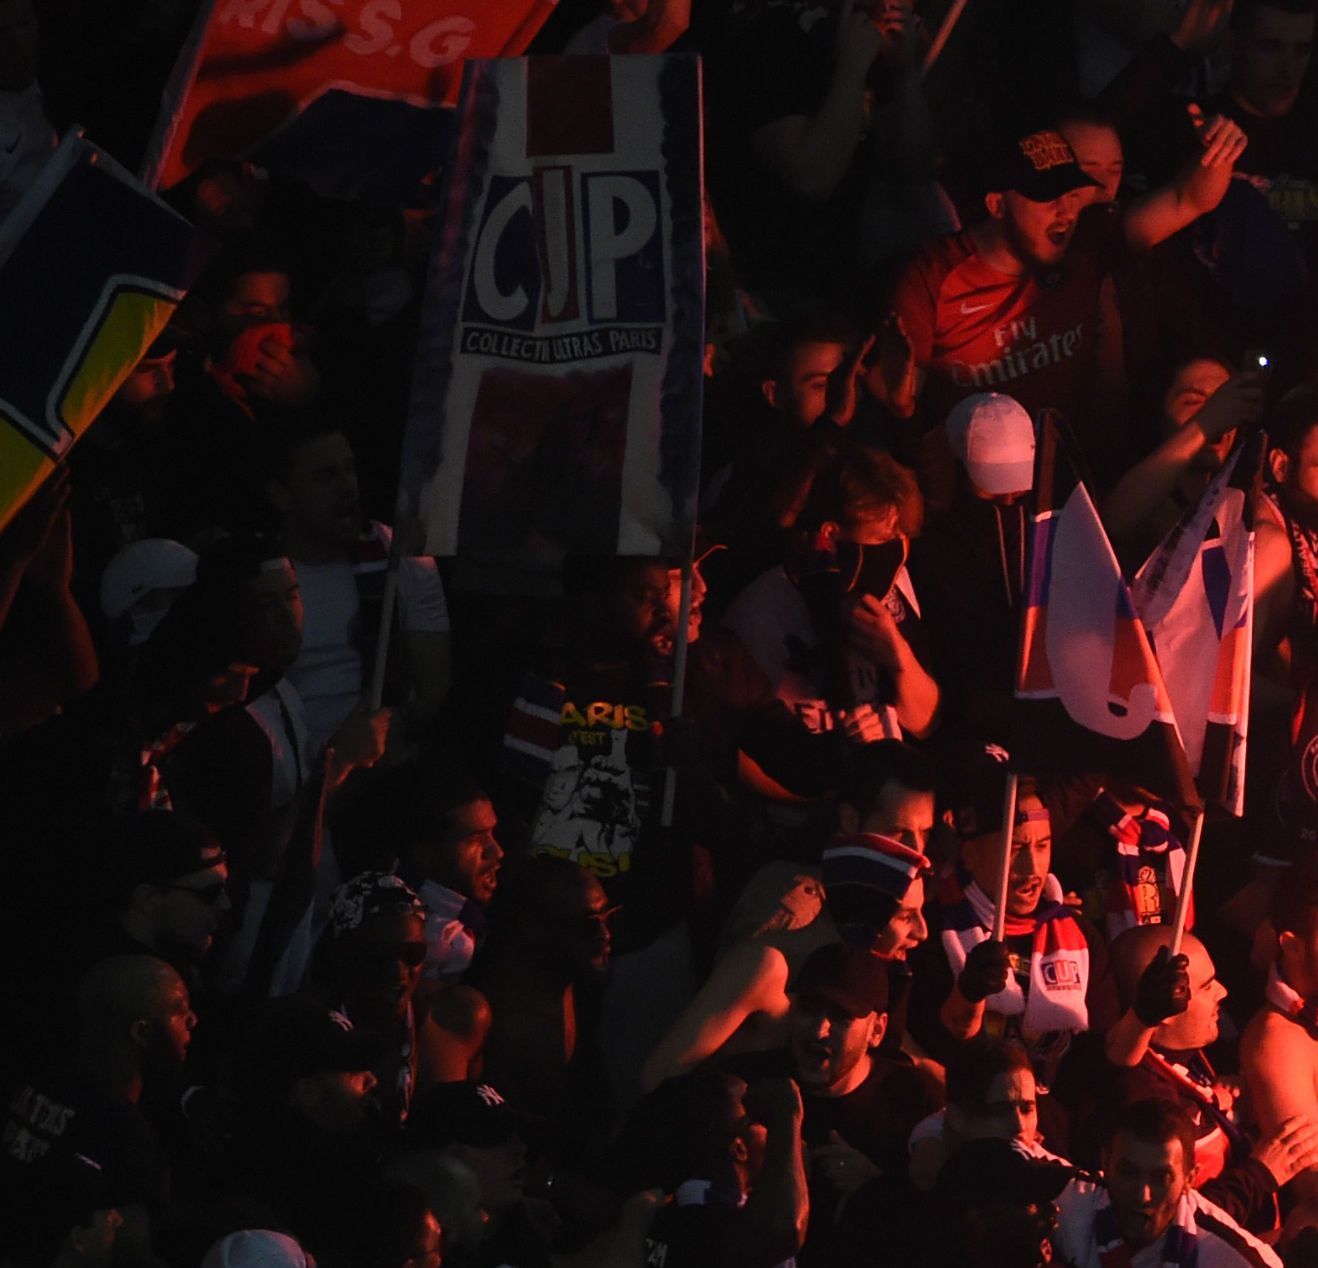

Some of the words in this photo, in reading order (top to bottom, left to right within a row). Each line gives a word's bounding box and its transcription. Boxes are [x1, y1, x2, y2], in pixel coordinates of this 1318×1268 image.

[609, 329, 657, 350] PARIS
[994, 316, 1037, 347] Fly
[560, 701, 648, 732] ARIS
